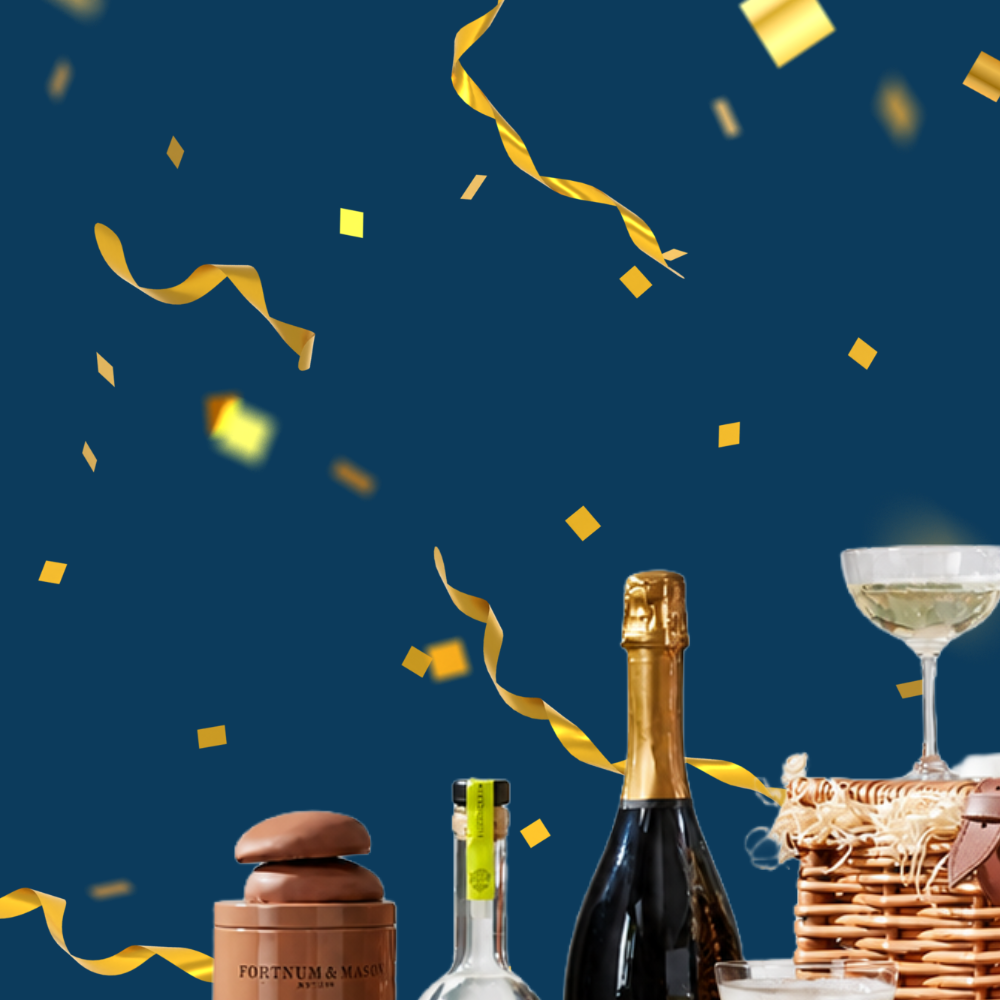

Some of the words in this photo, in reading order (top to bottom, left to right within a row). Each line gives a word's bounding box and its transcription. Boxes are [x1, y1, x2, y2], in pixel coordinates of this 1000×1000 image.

[239, 965, 321, 979] FORTNUM
[325, 966, 337, 979] &
[341, 963, 385, 979] MASON
